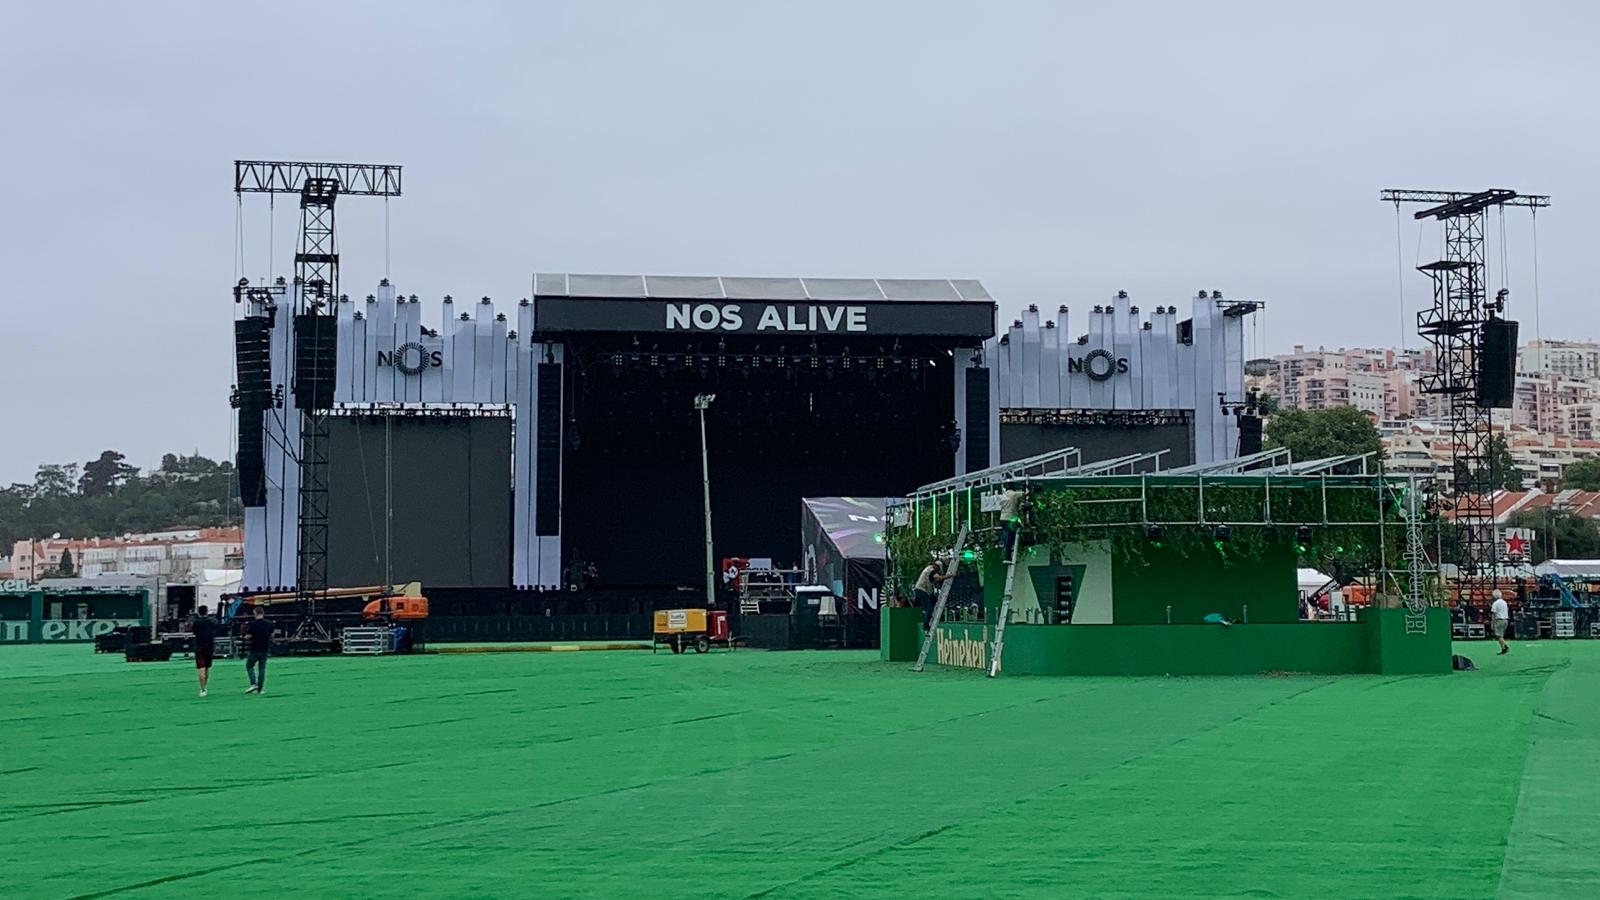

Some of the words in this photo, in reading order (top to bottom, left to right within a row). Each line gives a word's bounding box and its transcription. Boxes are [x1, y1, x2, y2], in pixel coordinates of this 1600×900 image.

[666, 303, 743, 331] NOS
[757, 305, 868, 332] ALIVE
[377, 342, 443, 376] NOS
[1067, 349, 1129, 381] NOS
[936, 628, 986, 669] Heineken
